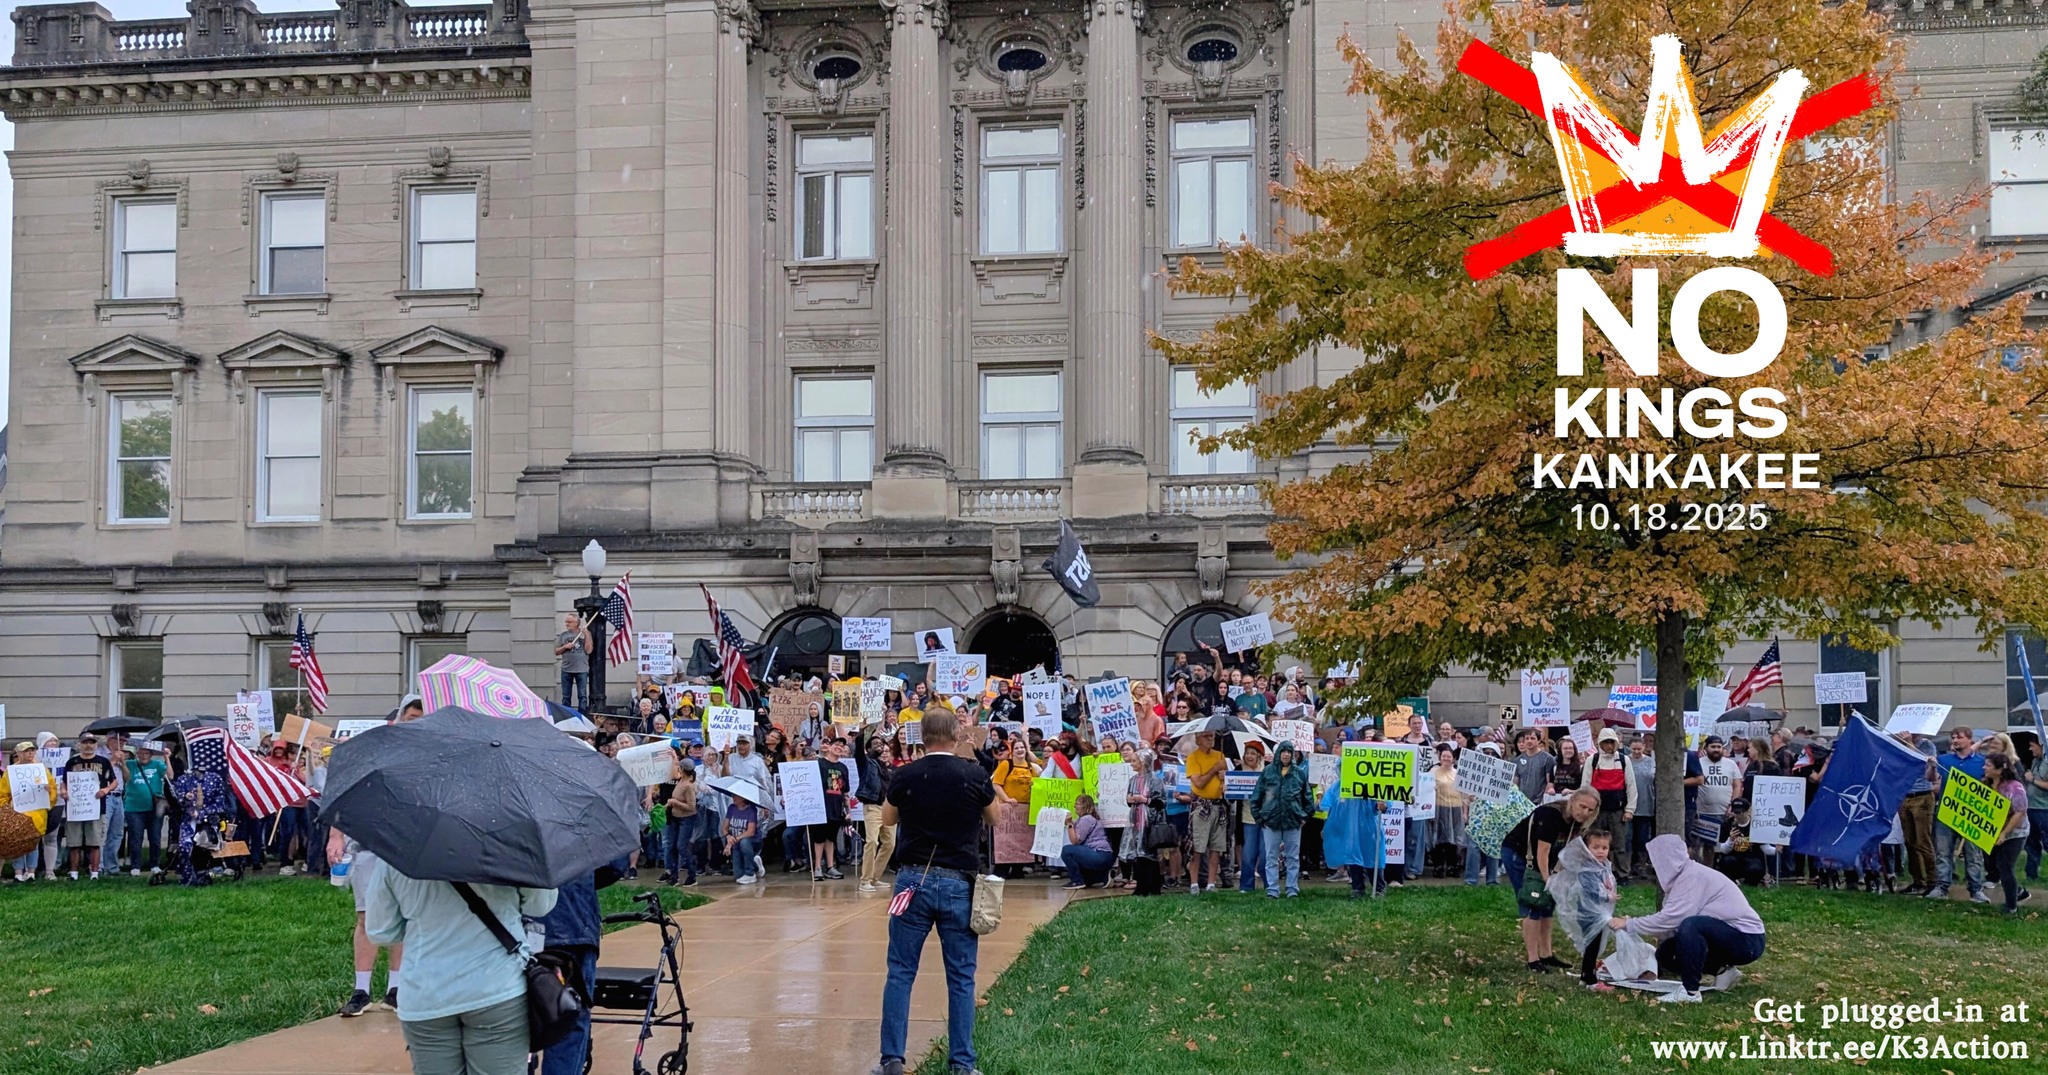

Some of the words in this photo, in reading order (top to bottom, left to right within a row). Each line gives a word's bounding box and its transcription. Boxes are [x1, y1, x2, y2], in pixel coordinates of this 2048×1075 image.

[1234, 618, 1250, 627] OUR
[1225, 624, 1261, 638] MILITARY!
[844, 636, 889, 649] GOVERNMENT
[1230, 636, 1245, 648] NOT
[1250, 632, 1267, 645] HIS!
[884, 681, 901, 689] INGS
[1617, 686, 1657, 694] AMERICA
[860, 688, 886, 698] HANDS
[1026, 689, 1055, 700] NOPE!
[1092, 680, 1128, 701] MELT
[233, 705, 248, 714] BY
[787, 707, 808, 716] STIL
[1101, 702, 1124, 714] ICE
[1629, 706, 1656, 716] PEOPL
[234, 723, 255, 733] FOR
[1098, 718, 1137, 733] BENEFITS
[1273, 721, 1288, 729] CAN
[1294, 722, 1307, 731] WE
[1274, 731, 1289, 739] GET
[41, 749, 63, 758] Think
[1344, 748, 1366, 758] BAD
[1371, 749, 1407, 761] BUNNY
[1461, 749, 1468, 757] IF
[1474, 752, 1496, 766] YOU'RE
[1502, 762, 1515, 772] NOT
[1100, 767, 1118, 782] We
[1356, 761, 1406, 778] OVER
[1459, 759, 1498, 778] OUTRAGED,
[1501, 771, 1512, 781] YOU
[1708, 766, 1722, 775] BE
[789, 772, 811, 784] NOT
[1320, 774, 1338, 784] NO
[1457, 769, 1468, 778] ARE
[1471, 773, 1485, 783] NOT
[1489, 778, 1510, 791] PAYING
[1704, 776, 1729, 786] KIND
[1045, 779, 1073, 789] TRUMP
[1755, 783, 1766, 795] I
[1770, 782, 1801, 795] PREFER
[1353, 782, 1415, 806] DUMMY
[1459, 780, 1500, 799] ATTENTION
[1950, 770, 1968, 787] NO
[1969, 782, 1991, 802] ONE
[1994, 795, 2004, 809] IS
[1046, 791, 1070, 801] WOULD
[1755, 798, 1767, 806] MY
[1954, 787, 1995, 821] ILLEGAL
[1385, 808, 1403, 816] NTRY
[1754, 808, 1775, 817] ICE
[1943, 796, 1959, 813] ON
[1960, 805, 1998, 838] STOLEN
[730, 818, 749, 828] AUNT
[1385, 829, 1400, 837] MED
[1952, 816, 1981, 841] LAND
[1385, 849, 1403, 857] MENT
